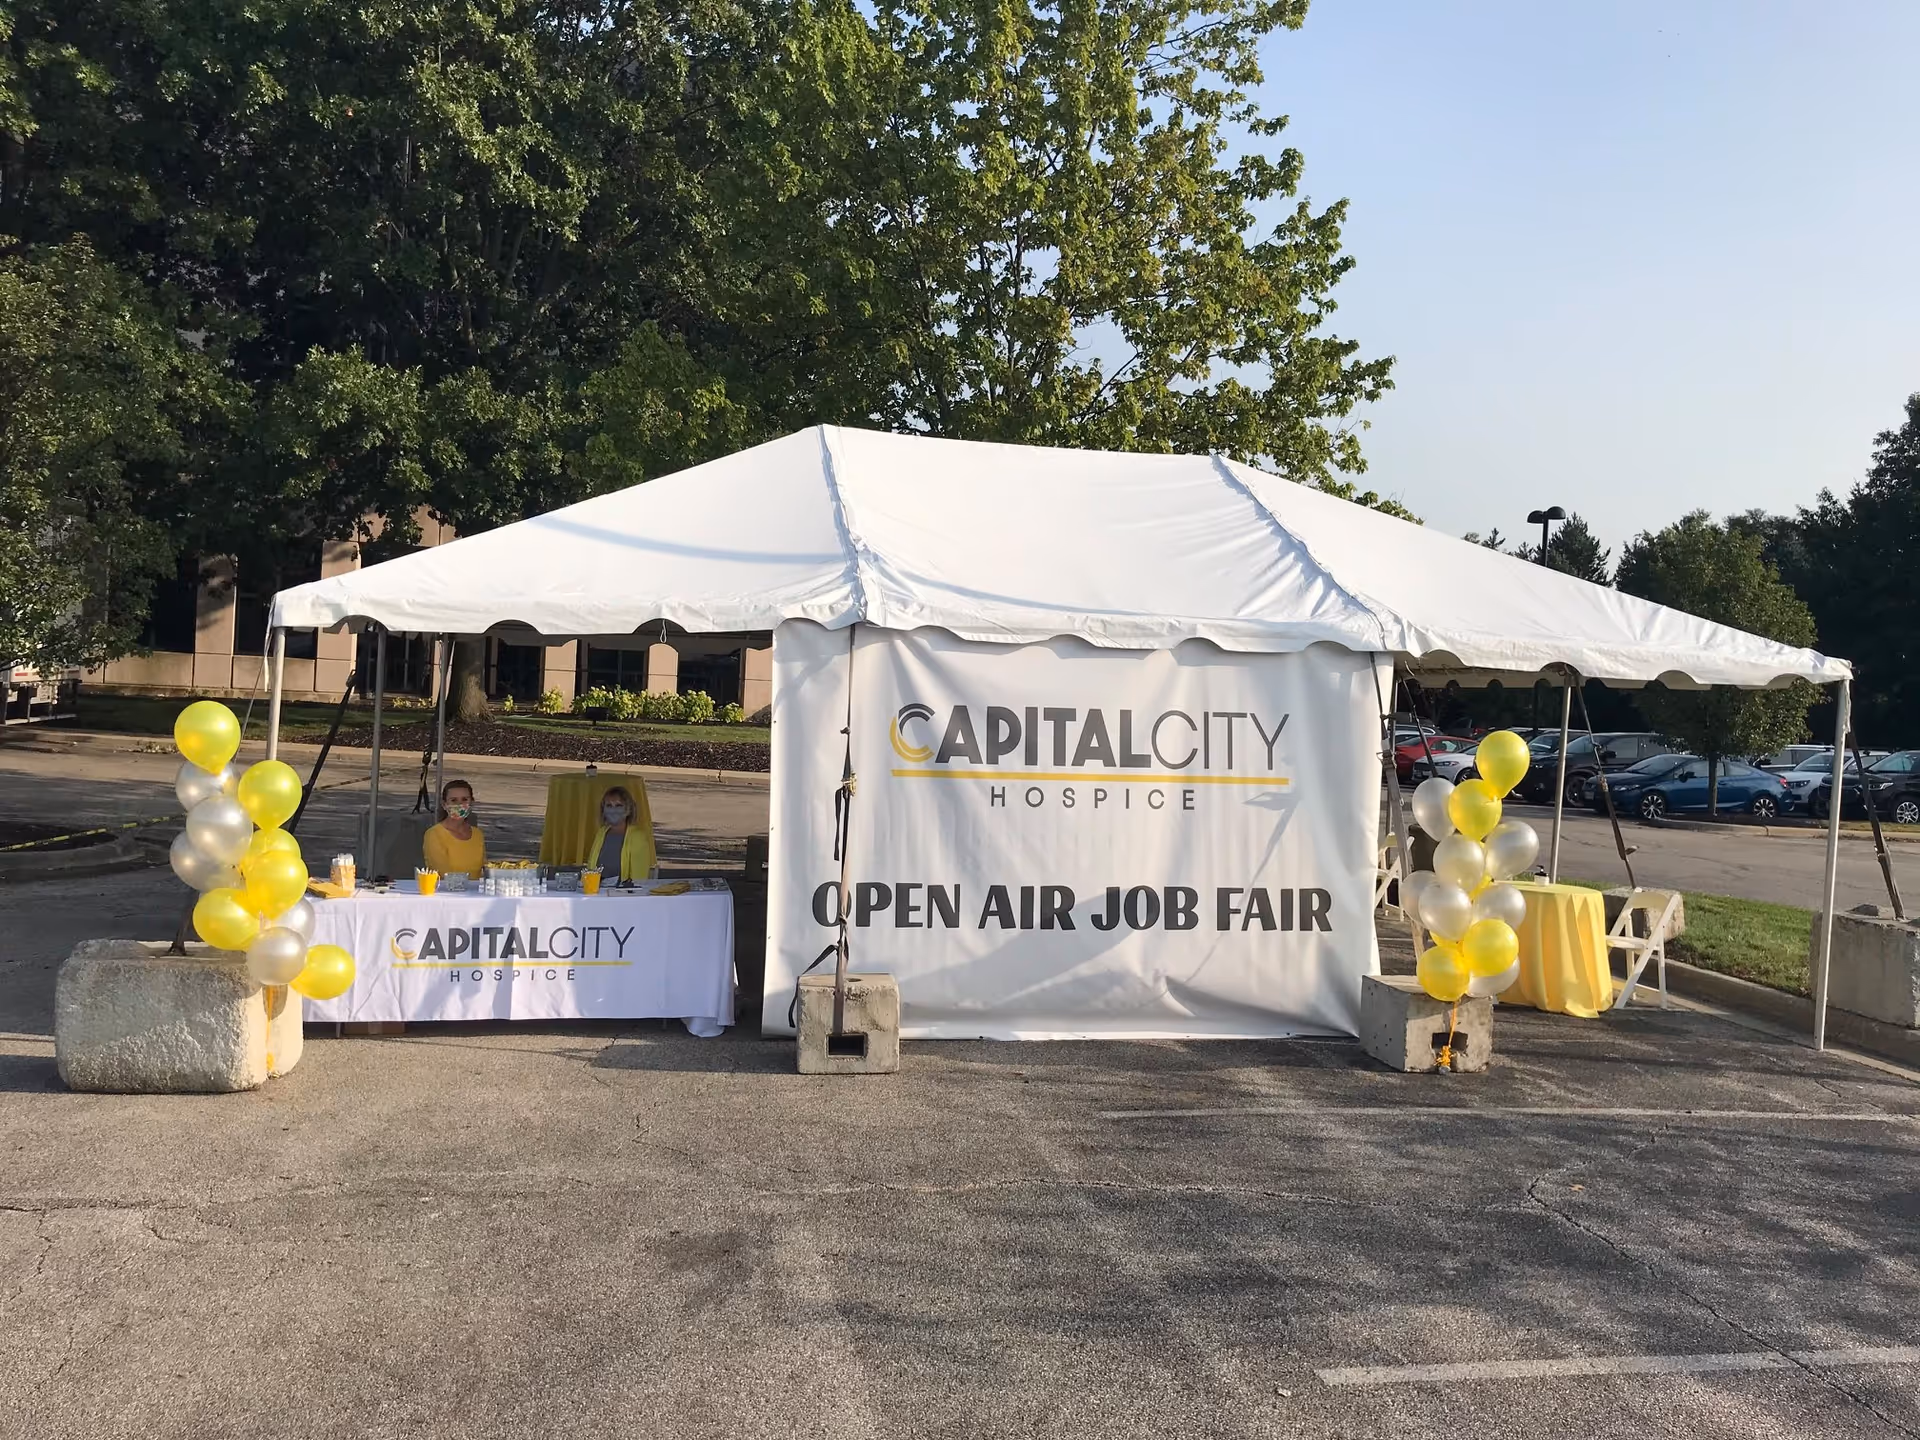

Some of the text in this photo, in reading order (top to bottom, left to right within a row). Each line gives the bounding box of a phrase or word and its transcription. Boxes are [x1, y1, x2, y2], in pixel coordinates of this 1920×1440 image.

[990, 786, 1196, 810] HOSPICE
[812, 881, 1333, 932] OPEN AIR JOB FAIR
[450, 969, 576, 983] HOSPICE
